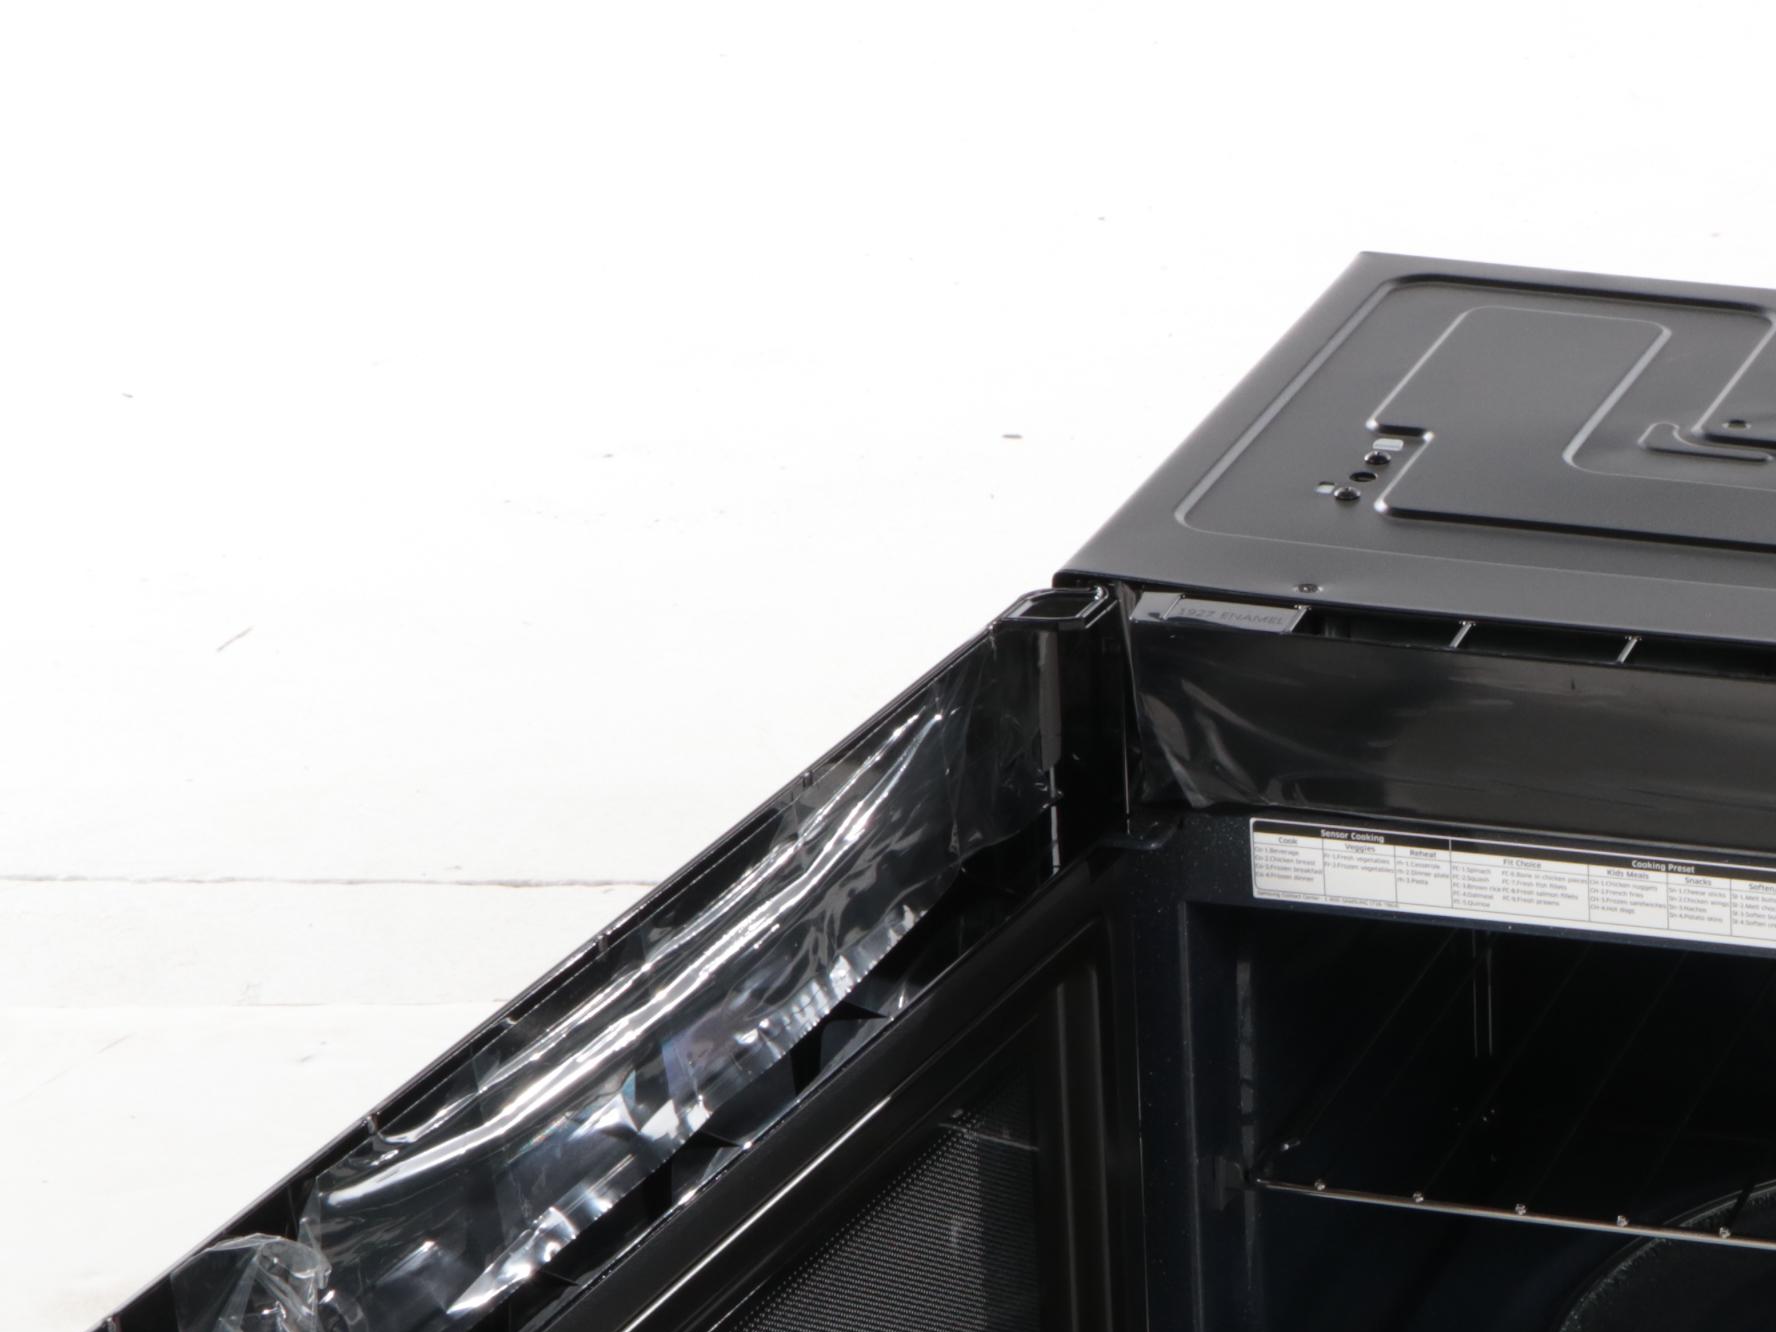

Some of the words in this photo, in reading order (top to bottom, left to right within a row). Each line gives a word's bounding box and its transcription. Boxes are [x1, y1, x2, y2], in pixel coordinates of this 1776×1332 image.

[1220, 611, 1284, 625] ENAMEL
[1278, 836, 1297, 844] Cook
[1320, 829, 1349, 839] Sensor
[1350, 833, 1384, 843] Cooking
[1345, 842, 1375, 854] Veggies
[1409, 849, 1436, 858] Reheat
[1503, 858, 1514, 866] Fit
[1515, 859, 1541, 868] Choice
[1632, 860, 1665, 871] Cooking
[1668, 863, 1694, 873] Preset
[1626, 871, 1648, 879] Meals
[1685, 877, 1711, 885] Snacks
